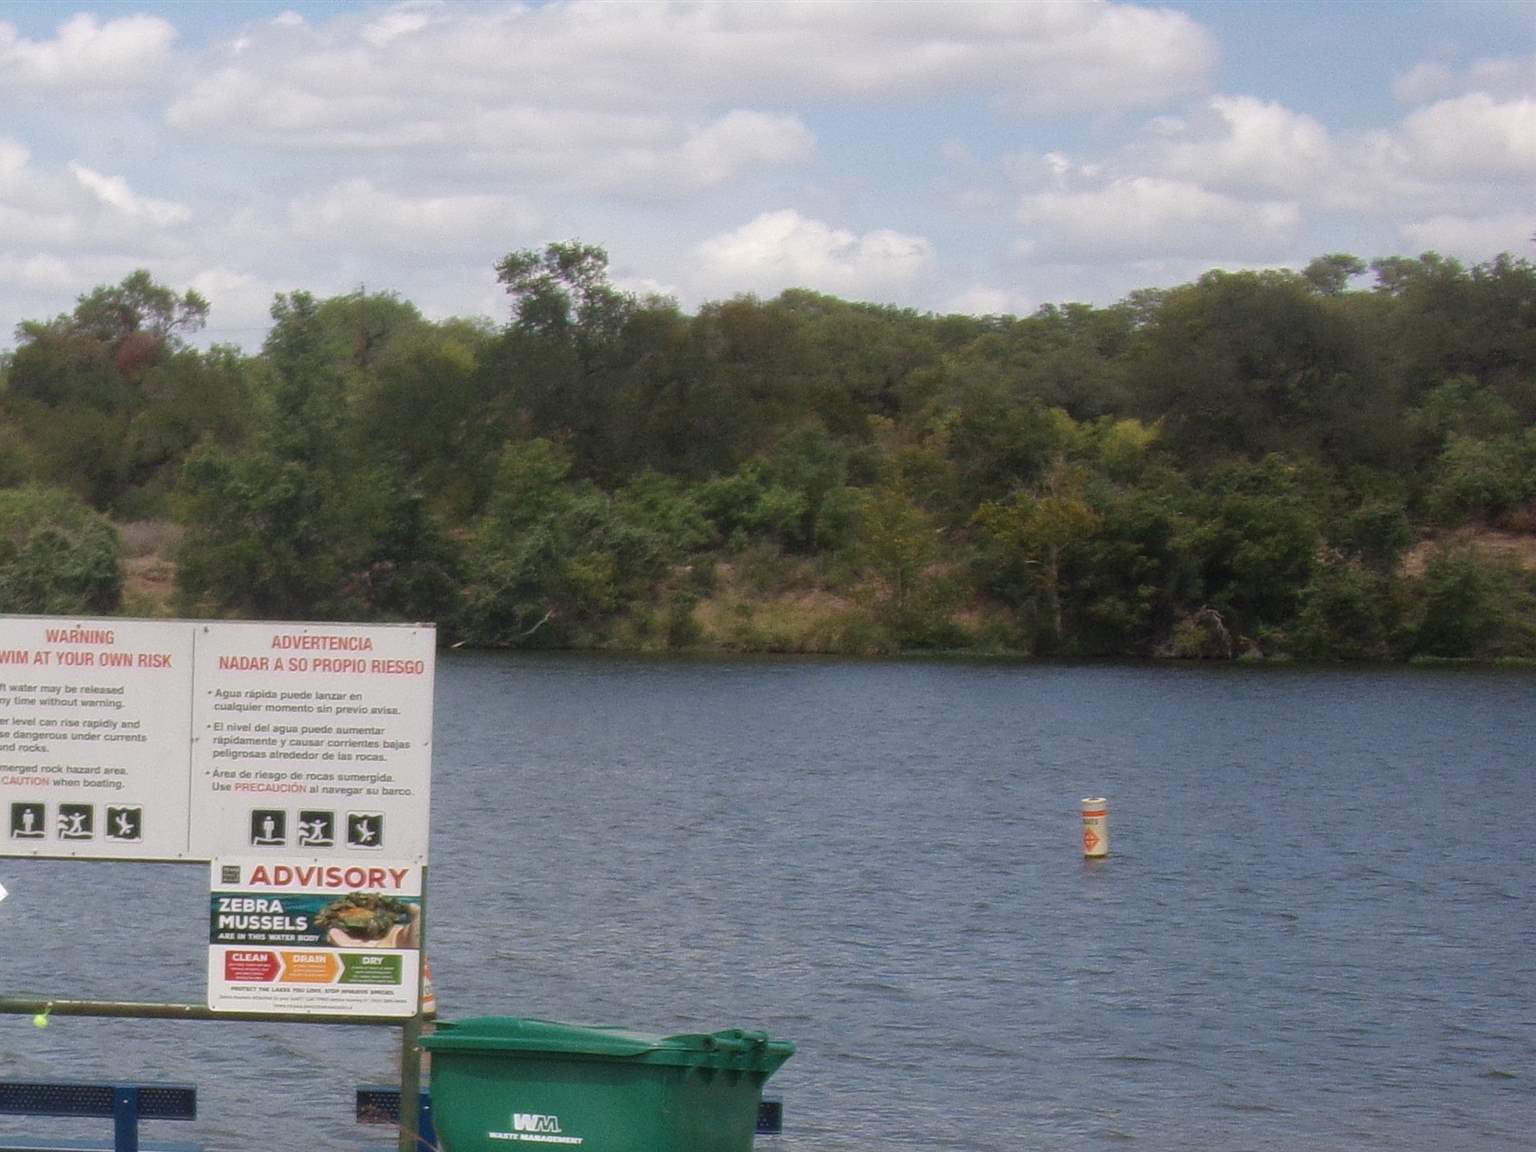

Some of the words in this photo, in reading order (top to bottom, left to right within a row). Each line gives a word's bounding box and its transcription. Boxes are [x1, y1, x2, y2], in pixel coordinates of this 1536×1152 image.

[45, 629, 115, 645] WARNING
[271, 635, 373, 652] ADVERTENCIA
[33, 650, 52, 665] AT
[56, 651, 95, 666] YOUR
[99, 652, 134, 667] OWN
[137, 653, 172, 668] RISK
[219, 655, 270, 671] NADAR
[273, 657, 284, 671] A
[288, 657, 308, 672] SO
[312, 657, 367, 674] PROPIO
[371, 659, 425, 675] RIESGO
[9, 684, 38, 692] water
[40, 685, 62, 696] may
[64, 685, 78, 694] be
[79, 685, 125, 695] released
[214, 688, 242, 700] Agua
[279, 691, 313, 701] puede
[315, 691, 347, 701] lanzar
[349, 693, 362, 701] en
[14, 696, 37, 706] time
[39, 697, 78, 707] without
[80, 700, 126, 710] warning.
[214, 702, 262, 713] cualquier
[265, 704, 314, 713] momento
[316, 703, 333, 714] sin
[335, 706, 369, 716] previo
[12, 717, 36, 726] level
[39, 719, 58, 727] can
[60, 719, 80, 727] rise
[82, 719, 118, 730] rapidly
[121, 720, 141, 729] and
[213, 721, 224, 732] El
[226, 723, 252, 732] nivel
[254, 723, 270, 733] del
[272, 725, 299, 736] agua
[301, 725, 333, 735] puede
[335, 727, 385, 735] aumentar
[12, 730, 68, 742] dangerous
[71, 732, 102, 741] under
[103, 734, 147, 742] currents
[18, 744, 50, 753] rocks.
[280, 739, 287, 748] y
[289, 739, 324, 747] causar
[327, 740, 380, 749] corrientes
[382, 740, 411, 751] bajas
[212, 748, 267, 760] peligrosas
[321, 751, 335, 761] de
[337, 753, 353, 761] las
[40, 765, 63, 774] rock
[65, 765, 101, 775] hazard
[103, 767, 129, 775] area.
[238, 770, 252, 779] de
[254, 772, 288, 782] riesgo
[290, 771, 303, 780] de
[305, 773, 335, 781] rocas
[1, 776, 50, 786] CAUTION
[52, 778, 81, 787] when
[82, 779, 126, 791] boating.
[212, 782, 232, 791] Use
[309, 785, 319, 794] al
[321, 786, 364, 797] navegar
[250, 866, 409, 888] ADVISORY
[218, 898, 284, 913] ZEBRA
[218, 915, 308, 930] MUSSELS
[232, 953, 268, 961] CLEAN
[292, 955, 326, 963] DRAIN
[520, 1134, 583, 1144] MANAGEMENT
